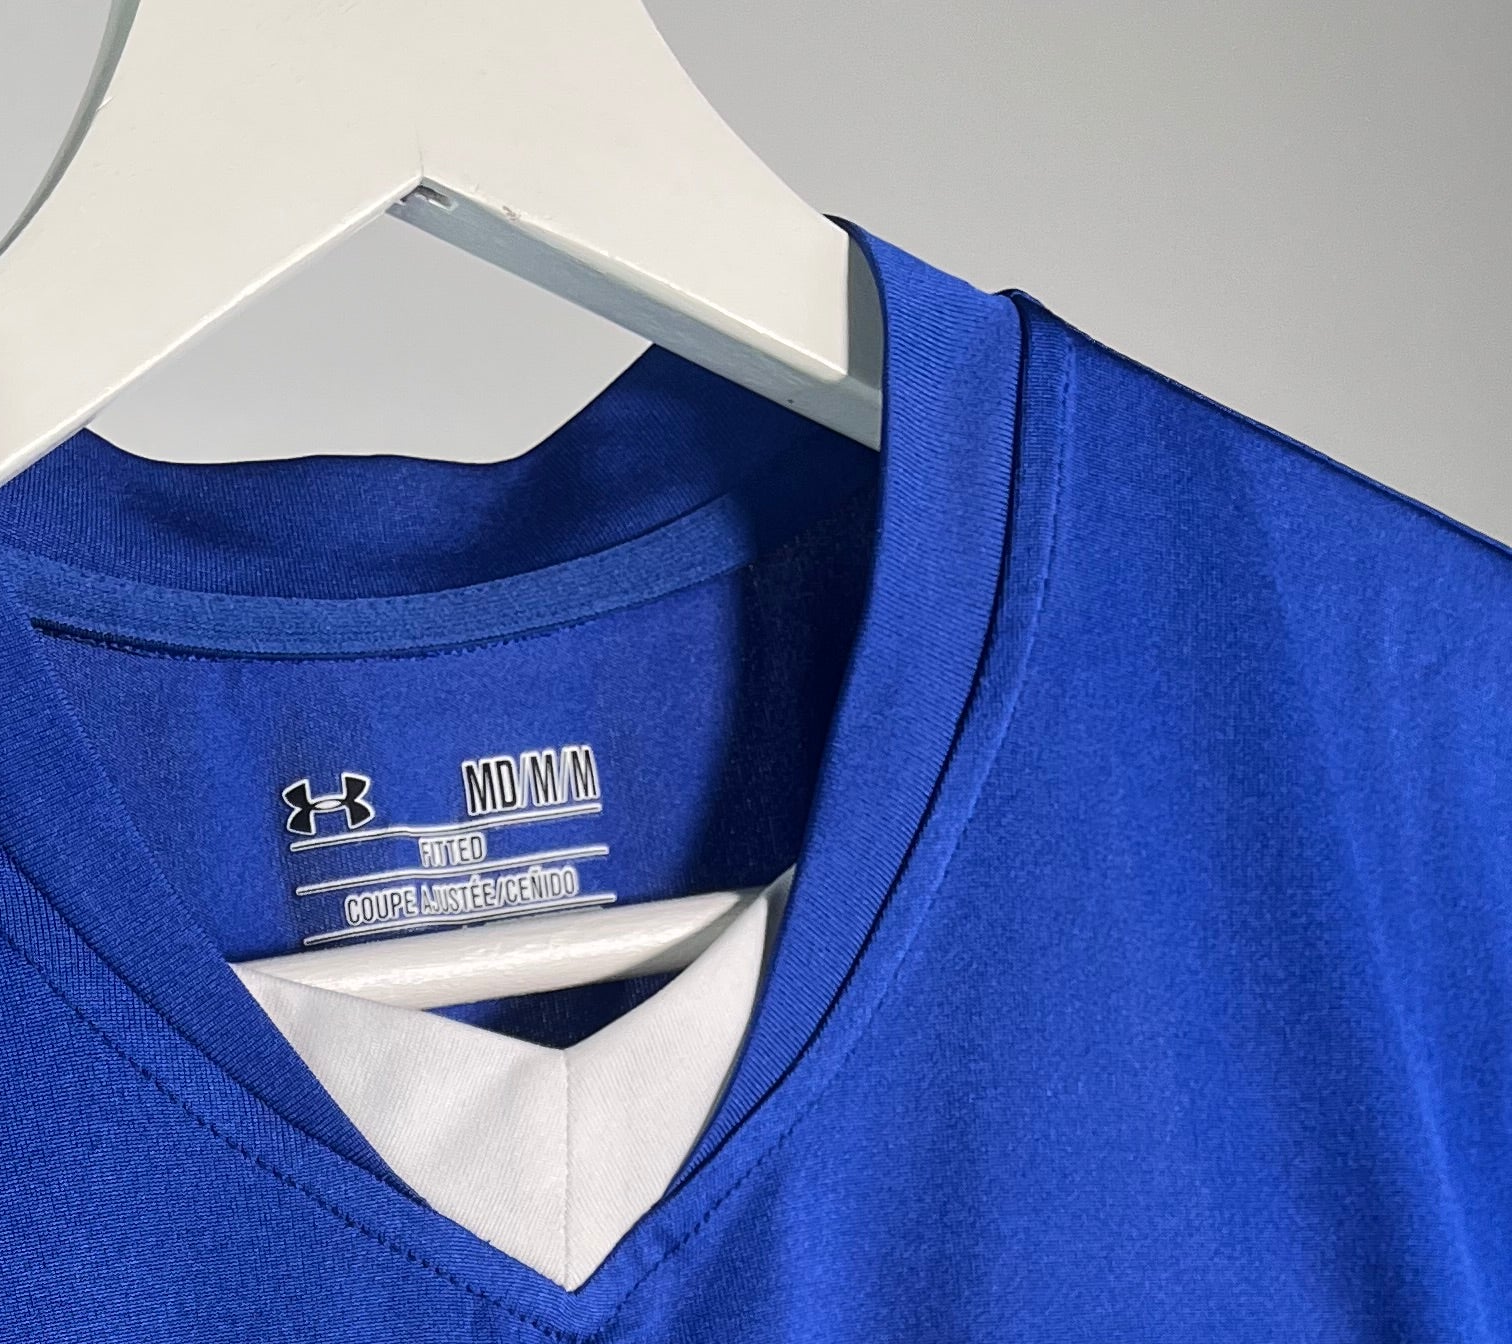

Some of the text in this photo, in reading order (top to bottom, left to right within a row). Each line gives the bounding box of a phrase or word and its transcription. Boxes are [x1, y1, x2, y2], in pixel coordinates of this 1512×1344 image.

[464, 746, 599, 815] MD/M/M
[420, 834, 485, 866] FITTED
[346, 888, 418, 925] COUPE
